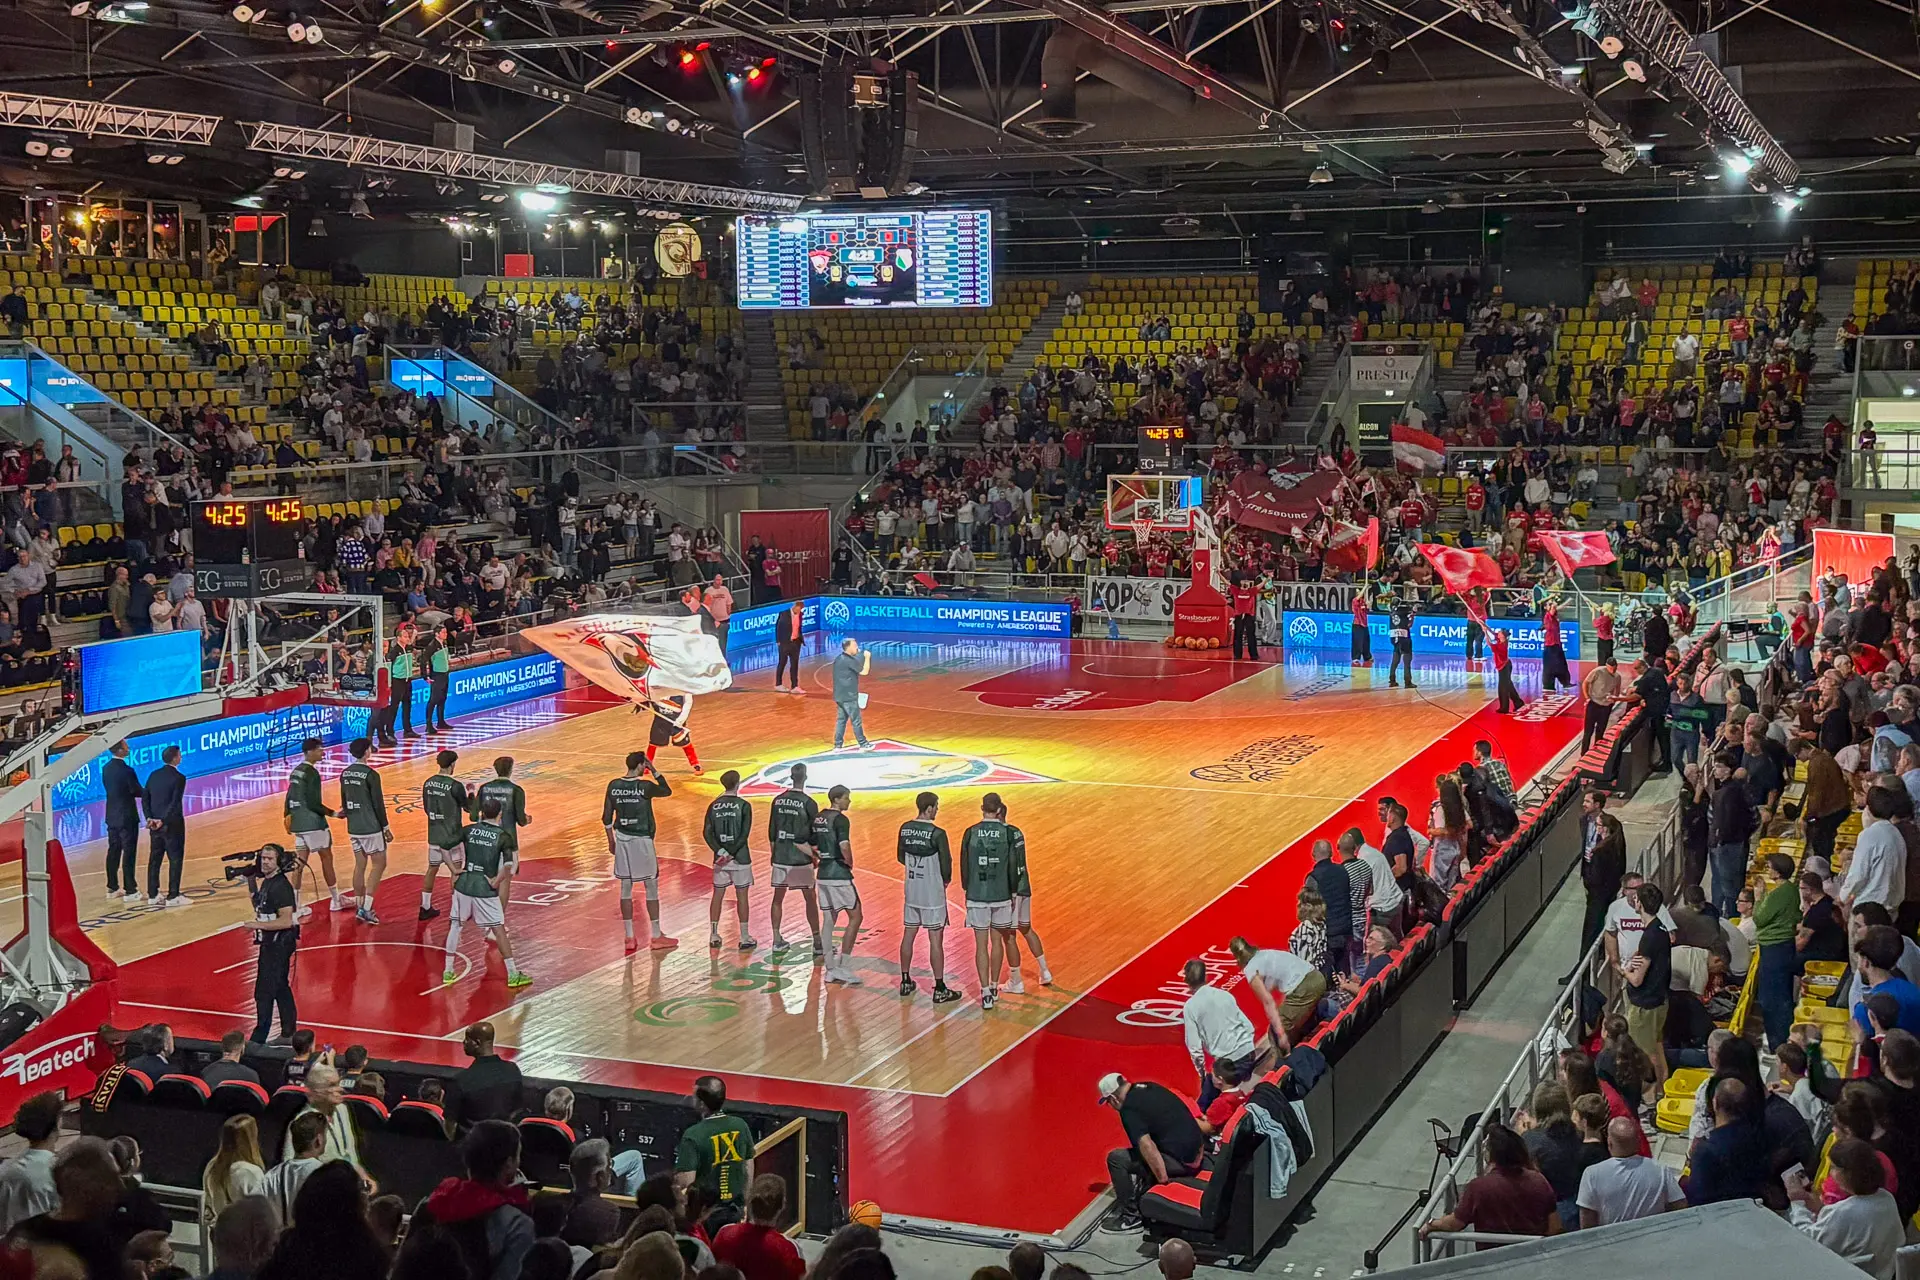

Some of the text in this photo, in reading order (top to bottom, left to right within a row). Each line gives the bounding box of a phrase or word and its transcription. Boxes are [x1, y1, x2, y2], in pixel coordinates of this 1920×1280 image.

[1357, 370, 1414, 380] PRESTIG
[1147, 429, 1169, 439] 4:25
[205, 505, 246, 525] 4:25
[266, 501, 301, 521] 4:25
[1092, 581, 1134, 613] KOP
[855, 605, 933, 619] BASKETBALL
[938, 607, 1009, 622] CHAMPIONS
[957, 621, 985, 629] Powered
[456, 668, 516, 695] CHAMPIONS
[201, 719, 280, 751] CHAMPIONS
[224, 744, 254, 757] Powered
[711, 1131, 743, 1168] IX
